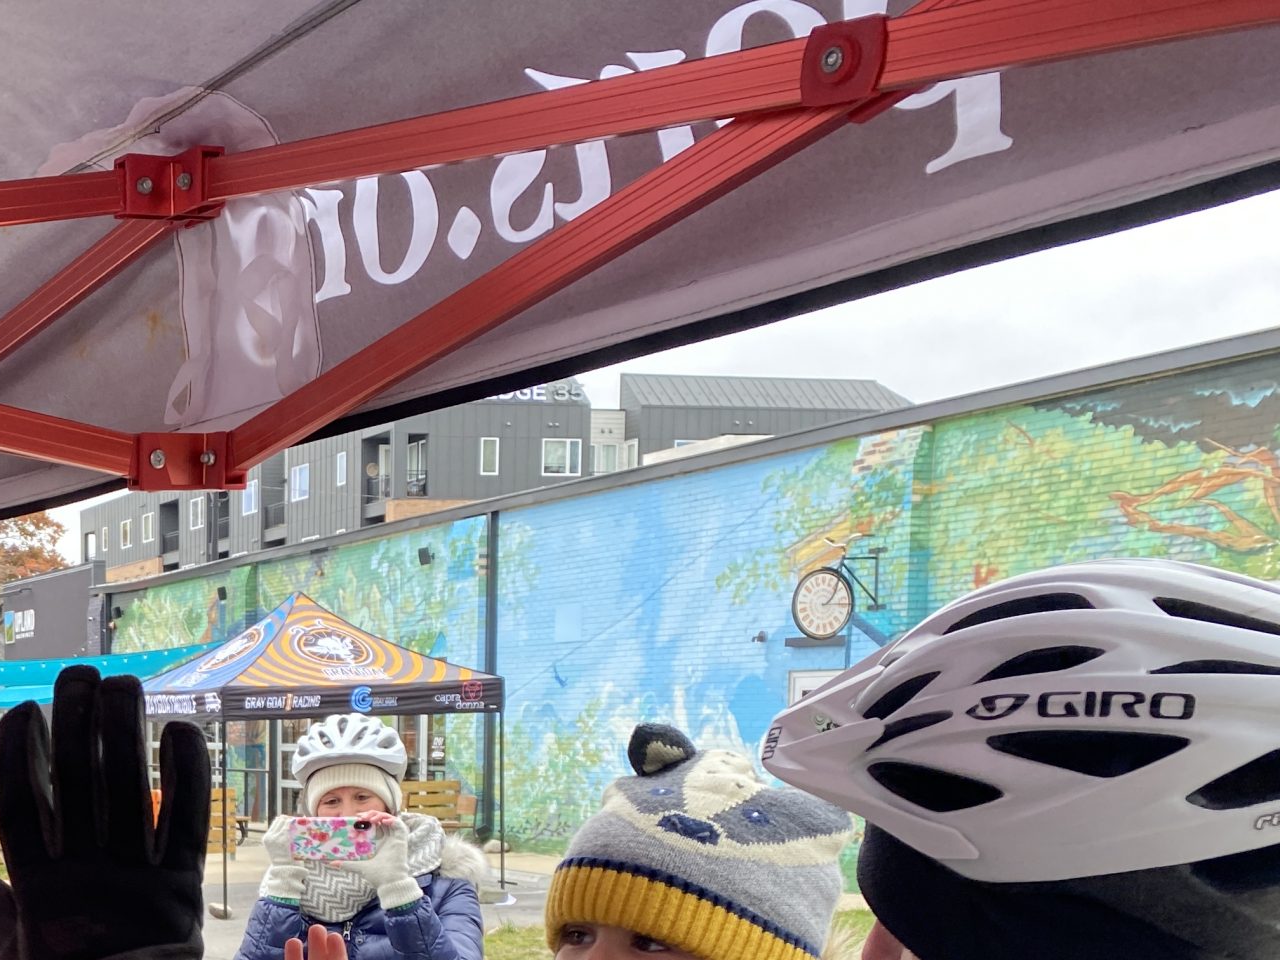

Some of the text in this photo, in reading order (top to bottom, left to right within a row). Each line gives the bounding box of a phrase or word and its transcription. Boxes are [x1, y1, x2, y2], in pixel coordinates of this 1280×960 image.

[554, 384, 584, 401] 35
[245, 695, 321, 709] GRAY GOAT RACING
[434, 694, 461, 705] capra
[456, 699, 485, 709] donna
[1037, 691, 1196, 720] GIRO
[762, 726, 783, 761] GIRO
